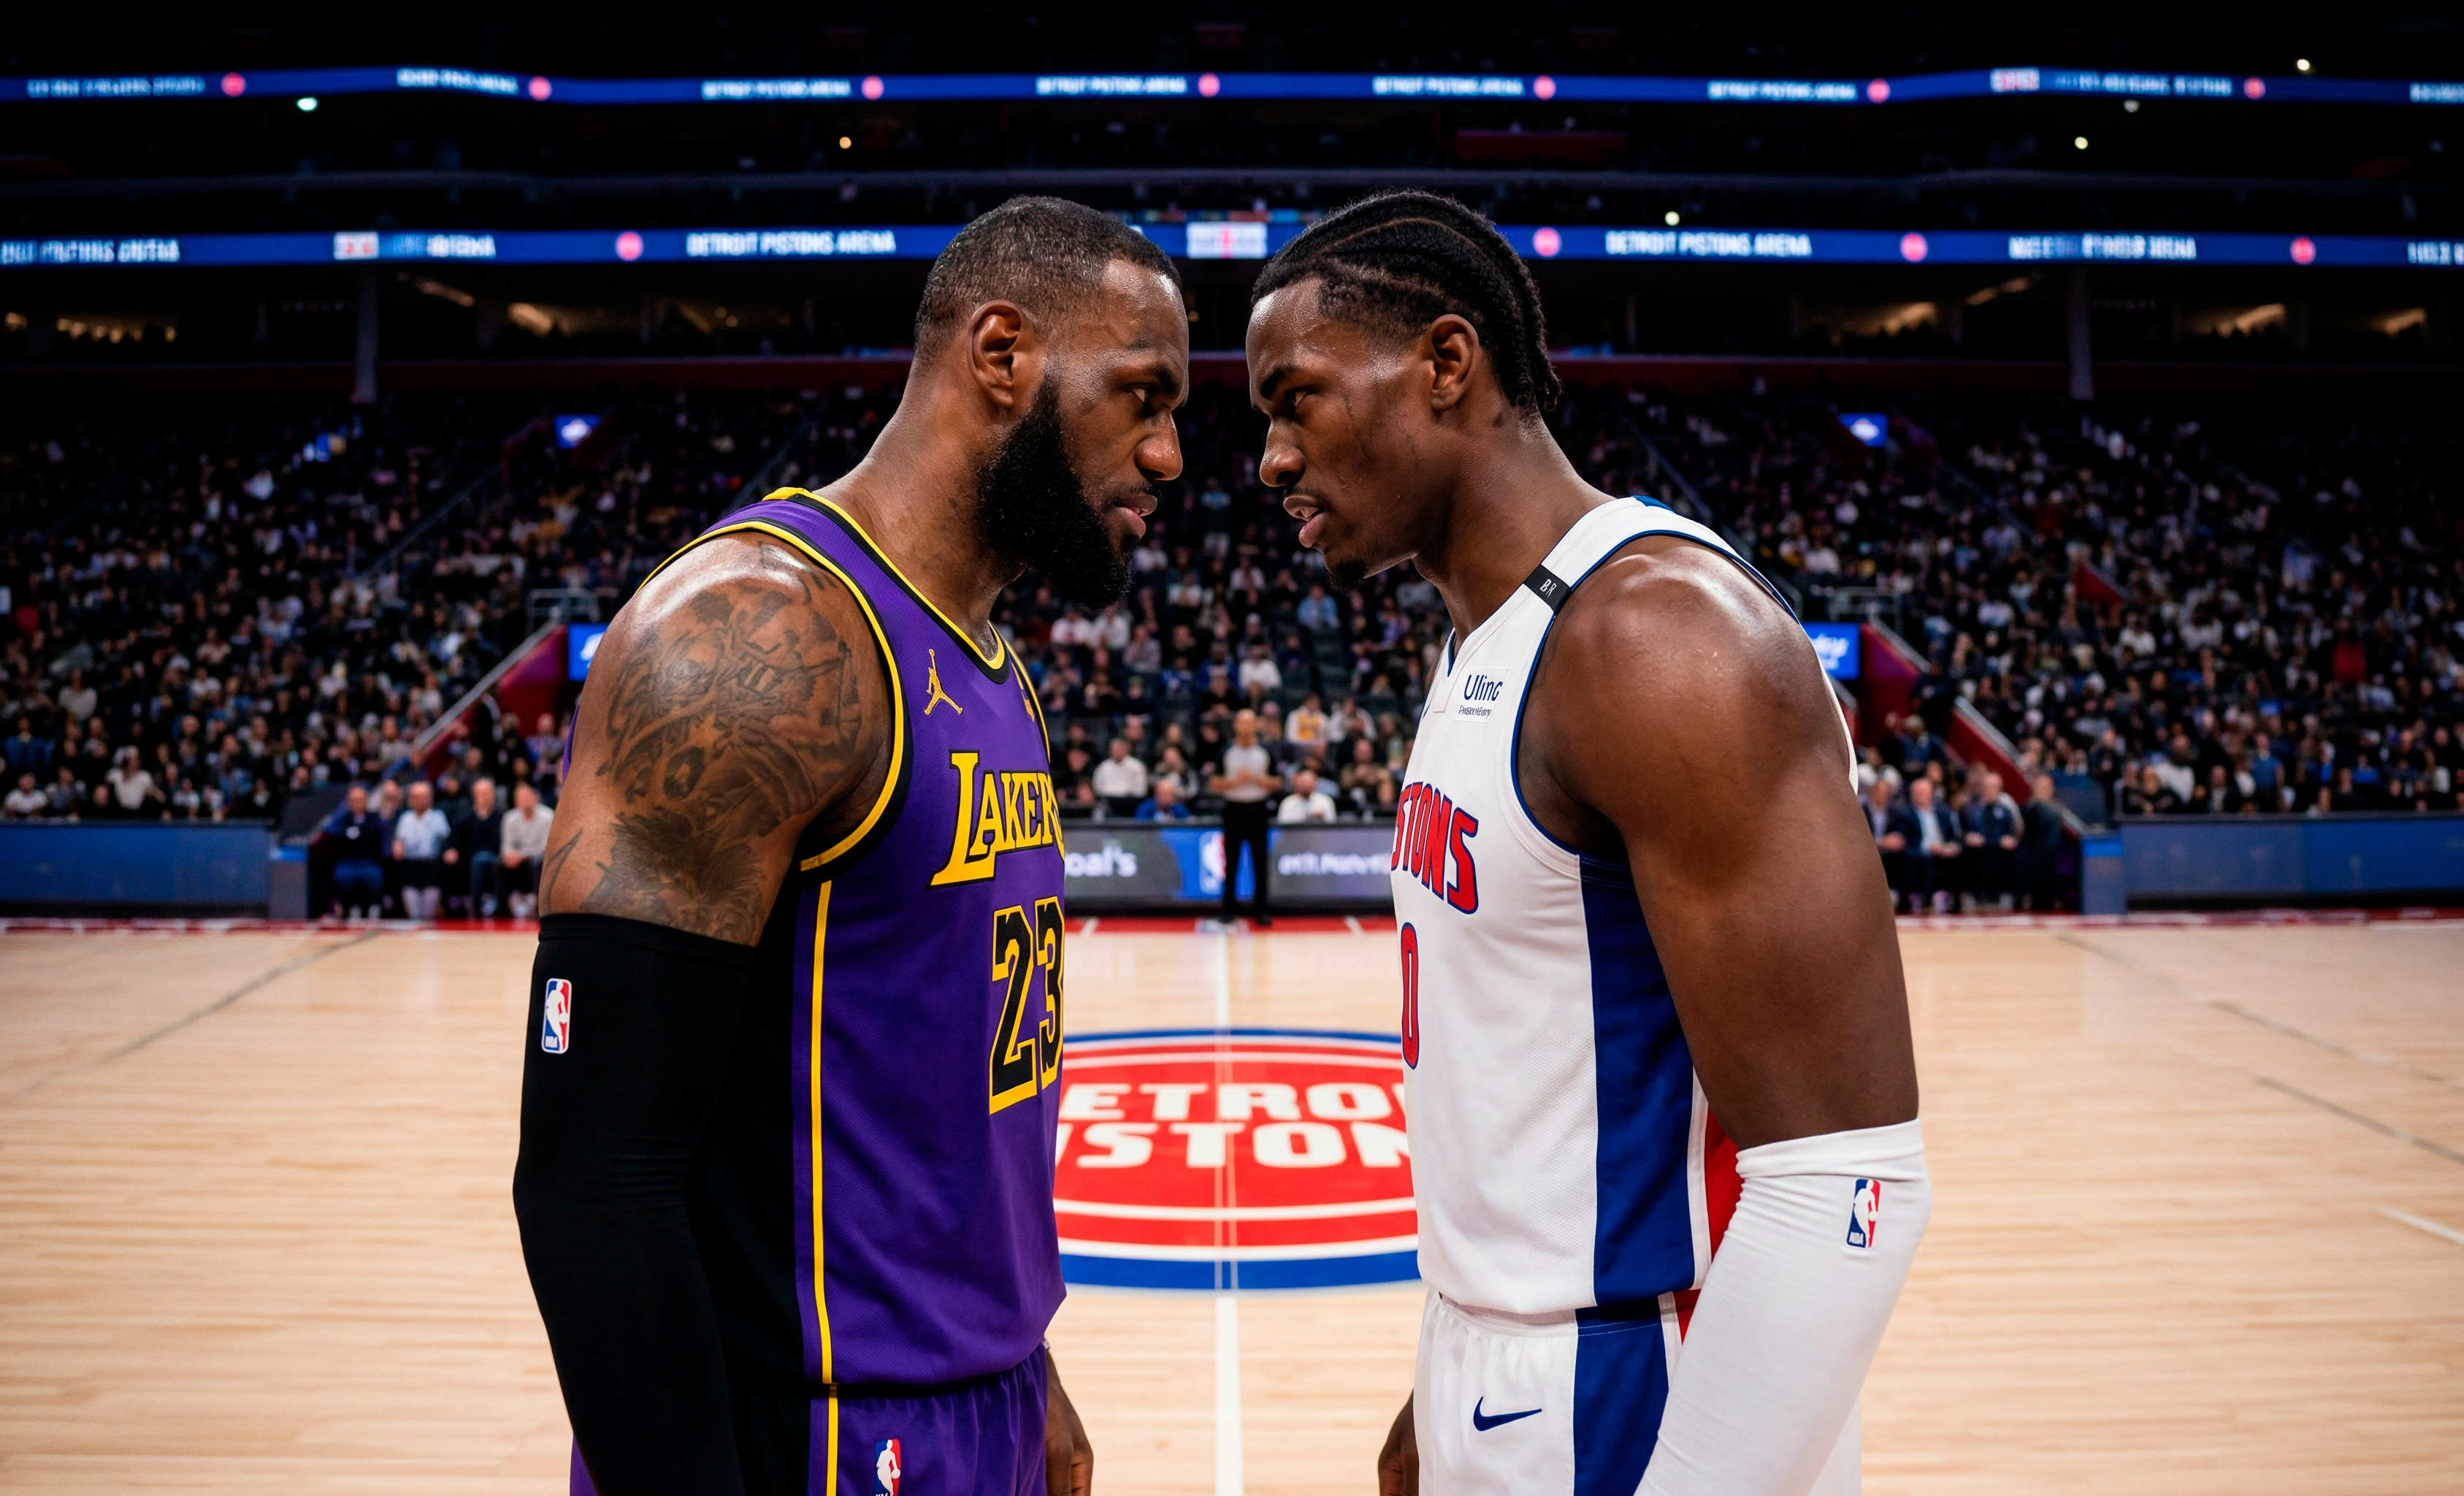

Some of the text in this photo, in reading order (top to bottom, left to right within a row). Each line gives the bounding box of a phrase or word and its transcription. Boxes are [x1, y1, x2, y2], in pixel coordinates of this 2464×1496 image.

[686, 230, 897, 257] DETROIT PISTONS ARENA
[1605, 230, 1813, 258] DETROIT PISTONS ARENA
[1539, 579, 1557, 598] BR
[989, 896, 1065, 1115] 23
